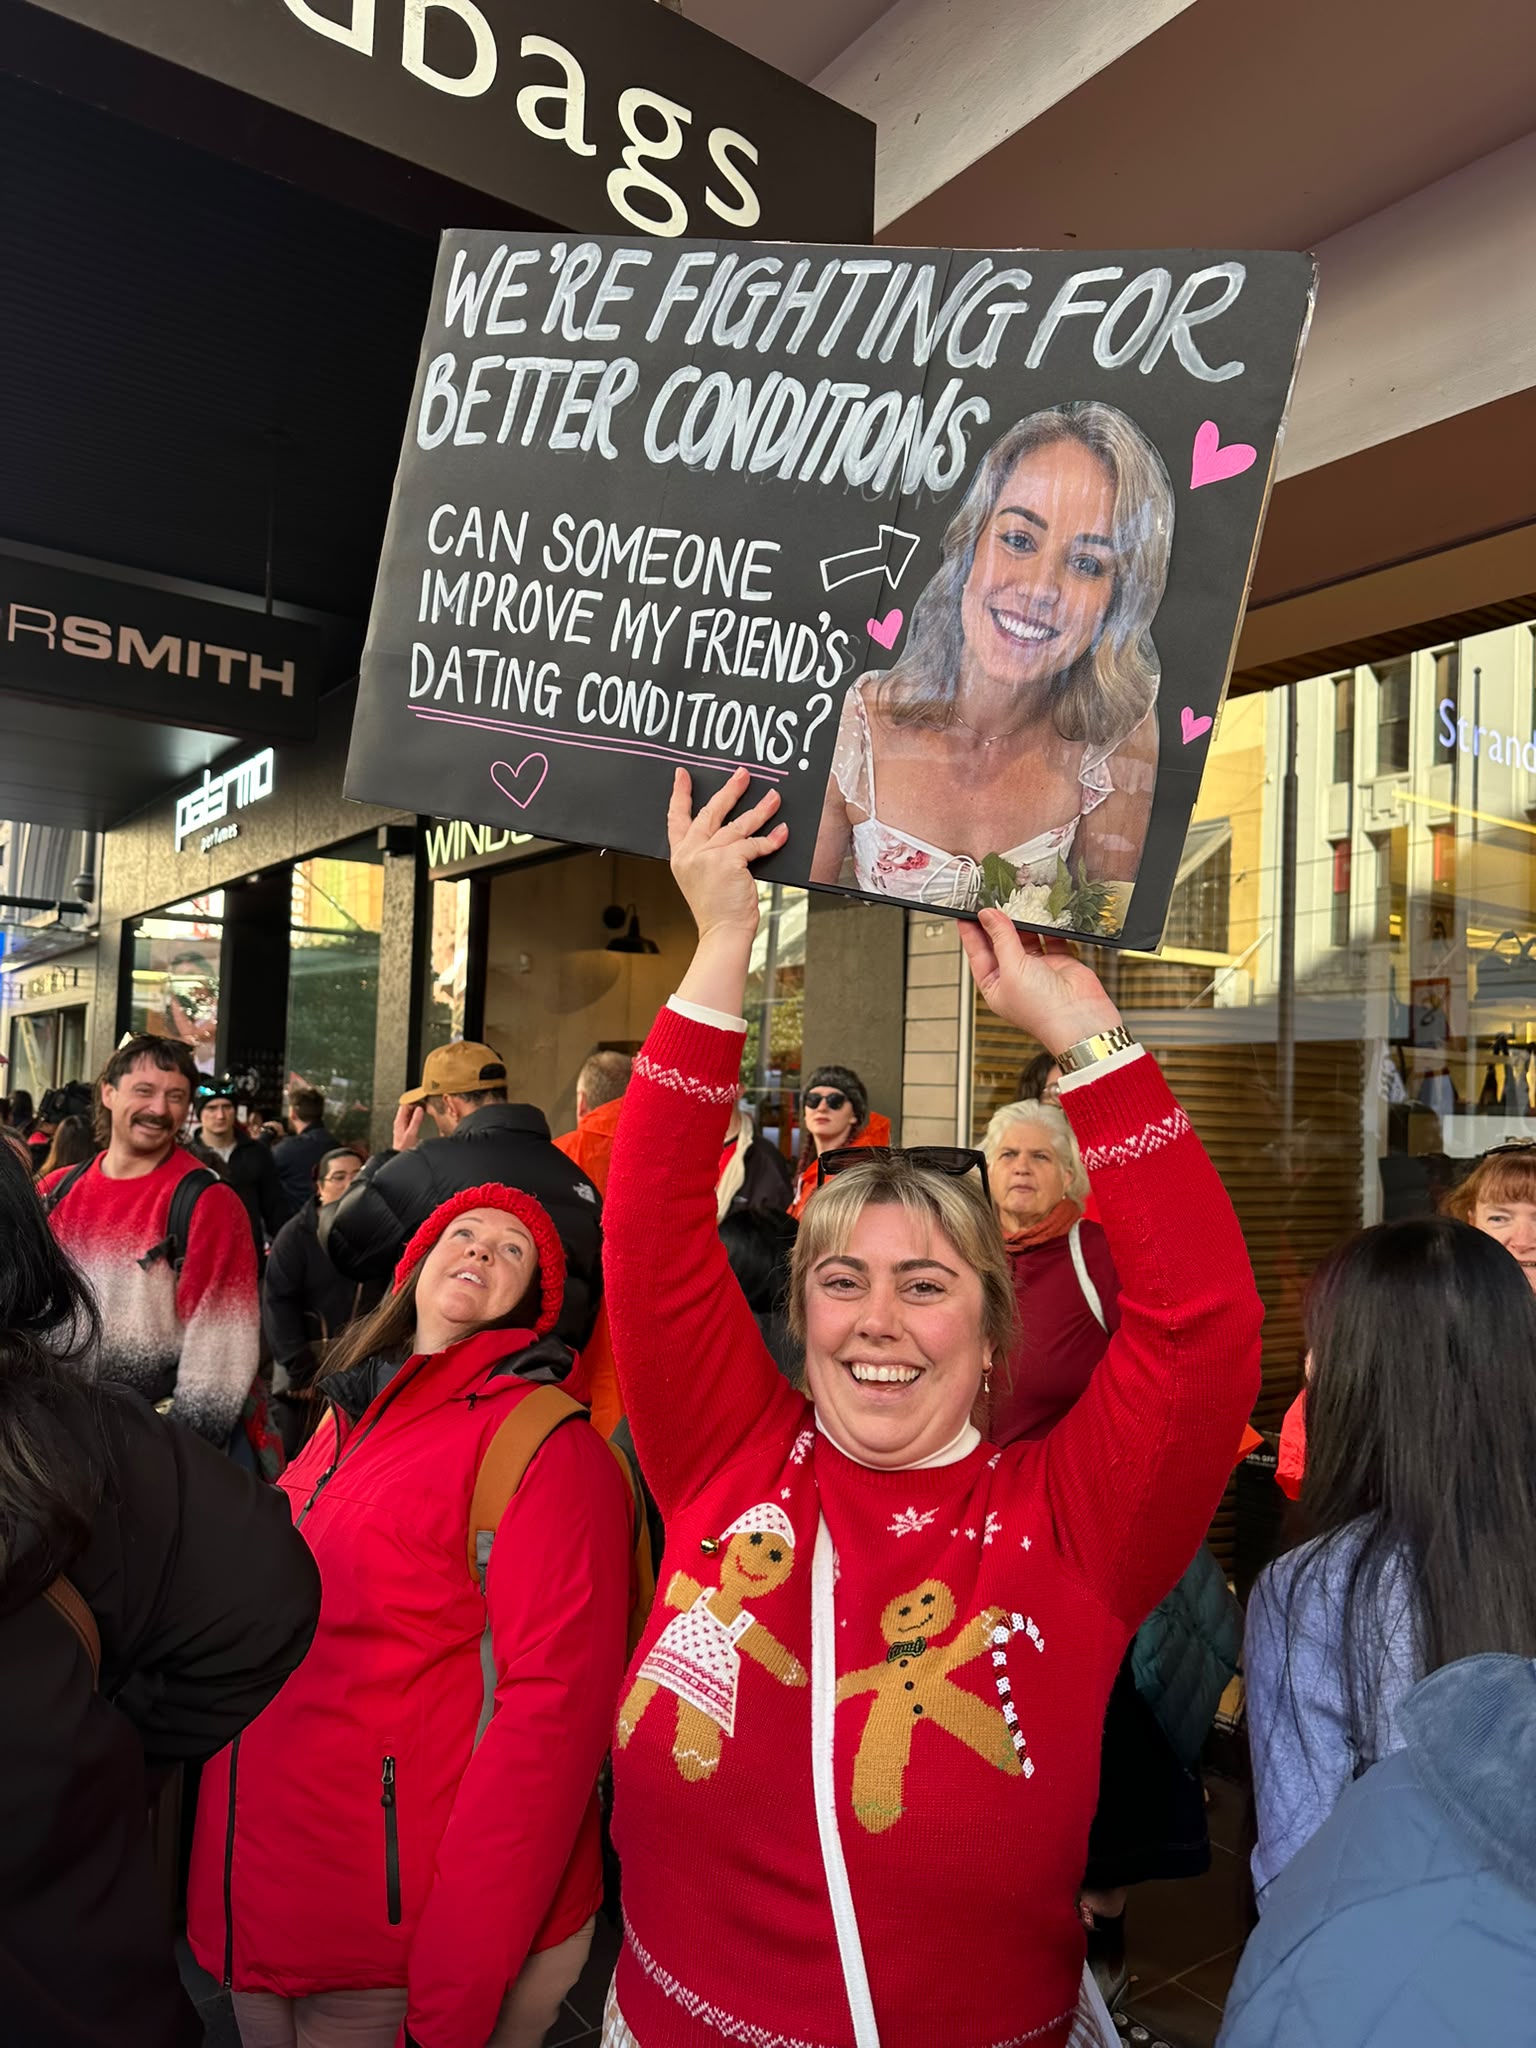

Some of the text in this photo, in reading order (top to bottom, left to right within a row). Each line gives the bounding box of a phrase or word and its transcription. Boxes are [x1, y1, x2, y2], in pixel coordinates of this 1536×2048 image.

[444, 242, 1247, 383] WE'RE FIGHTING FOR
[416, 352, 991, 495] BETTER CONDITIONS
[427, 503, 782, 602] CAN SOMEONE
[0, 602, 296, 697] RSMITH
[417, 568, 849, 689] IMPROVE MY FRIEND'S
[408, 642, 834, 771] DATING CONDITIONS?
[1437, 698, 1536, 774] Strand
